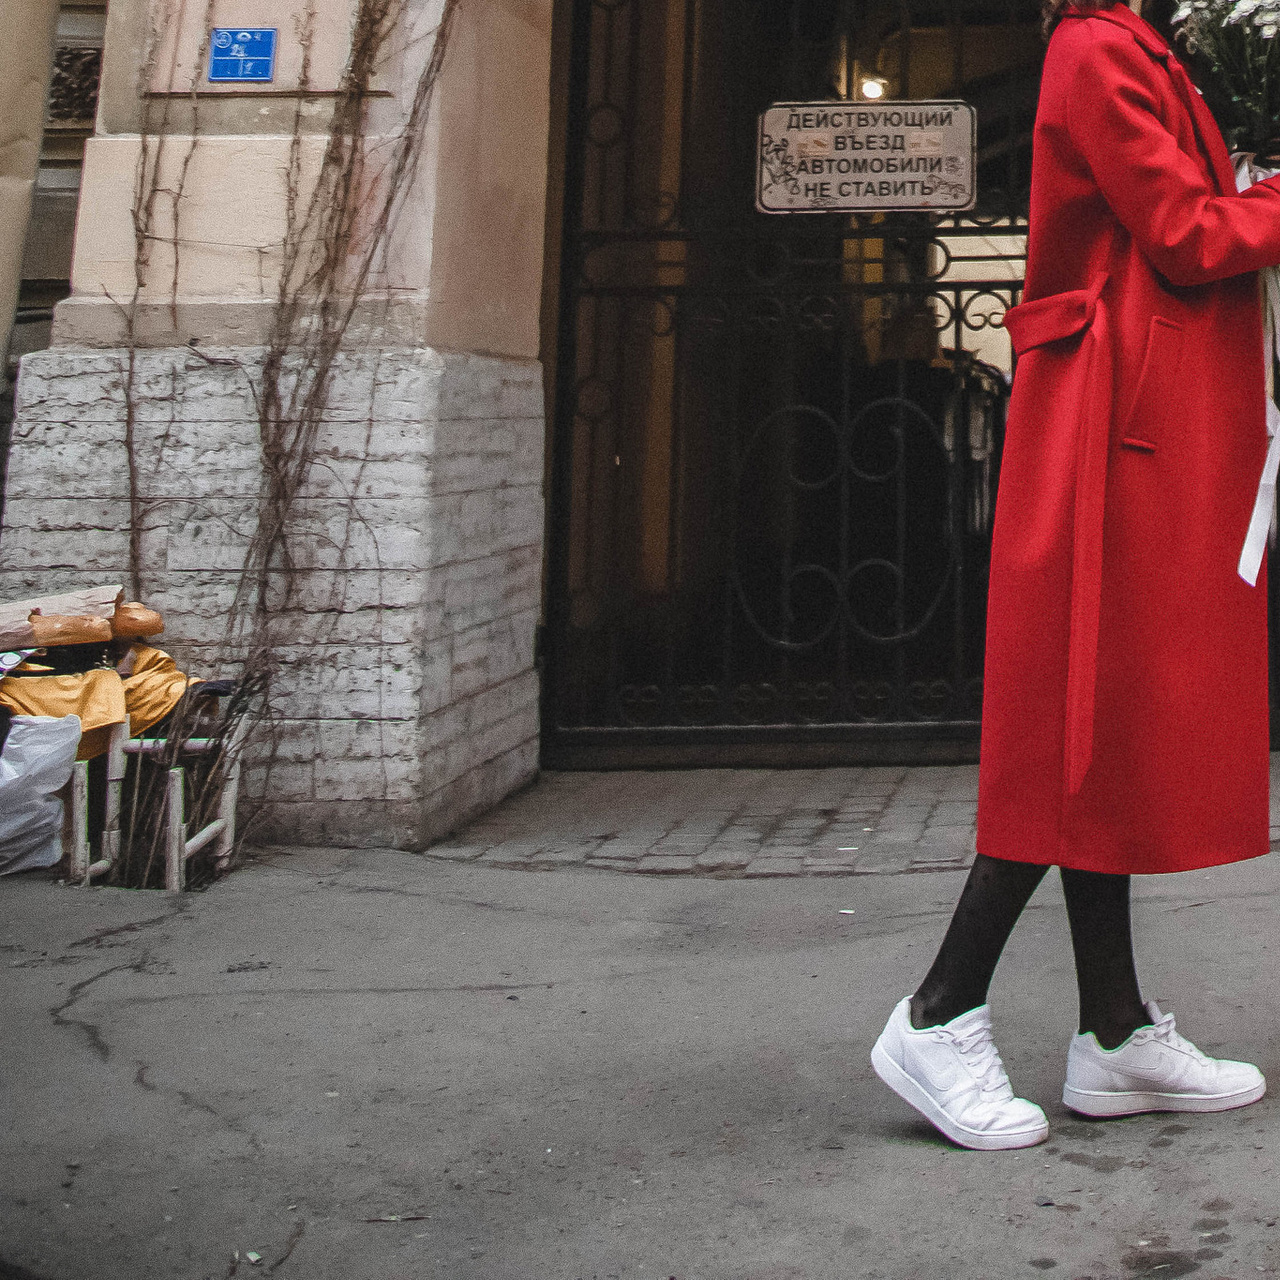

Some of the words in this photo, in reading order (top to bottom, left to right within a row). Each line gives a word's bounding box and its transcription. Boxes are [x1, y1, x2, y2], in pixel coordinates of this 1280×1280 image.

[786, 108, 953, 130] ДЕЙСТВУЮЩИЙ
[834, 134, 905, 153] ВЪЕЗД
[796, 157, 942, 175] АВТОМОБИЛИ
[804, 182, 831, 198] НЕ
[838, 180, 934, 198] СТАВИТЬ
